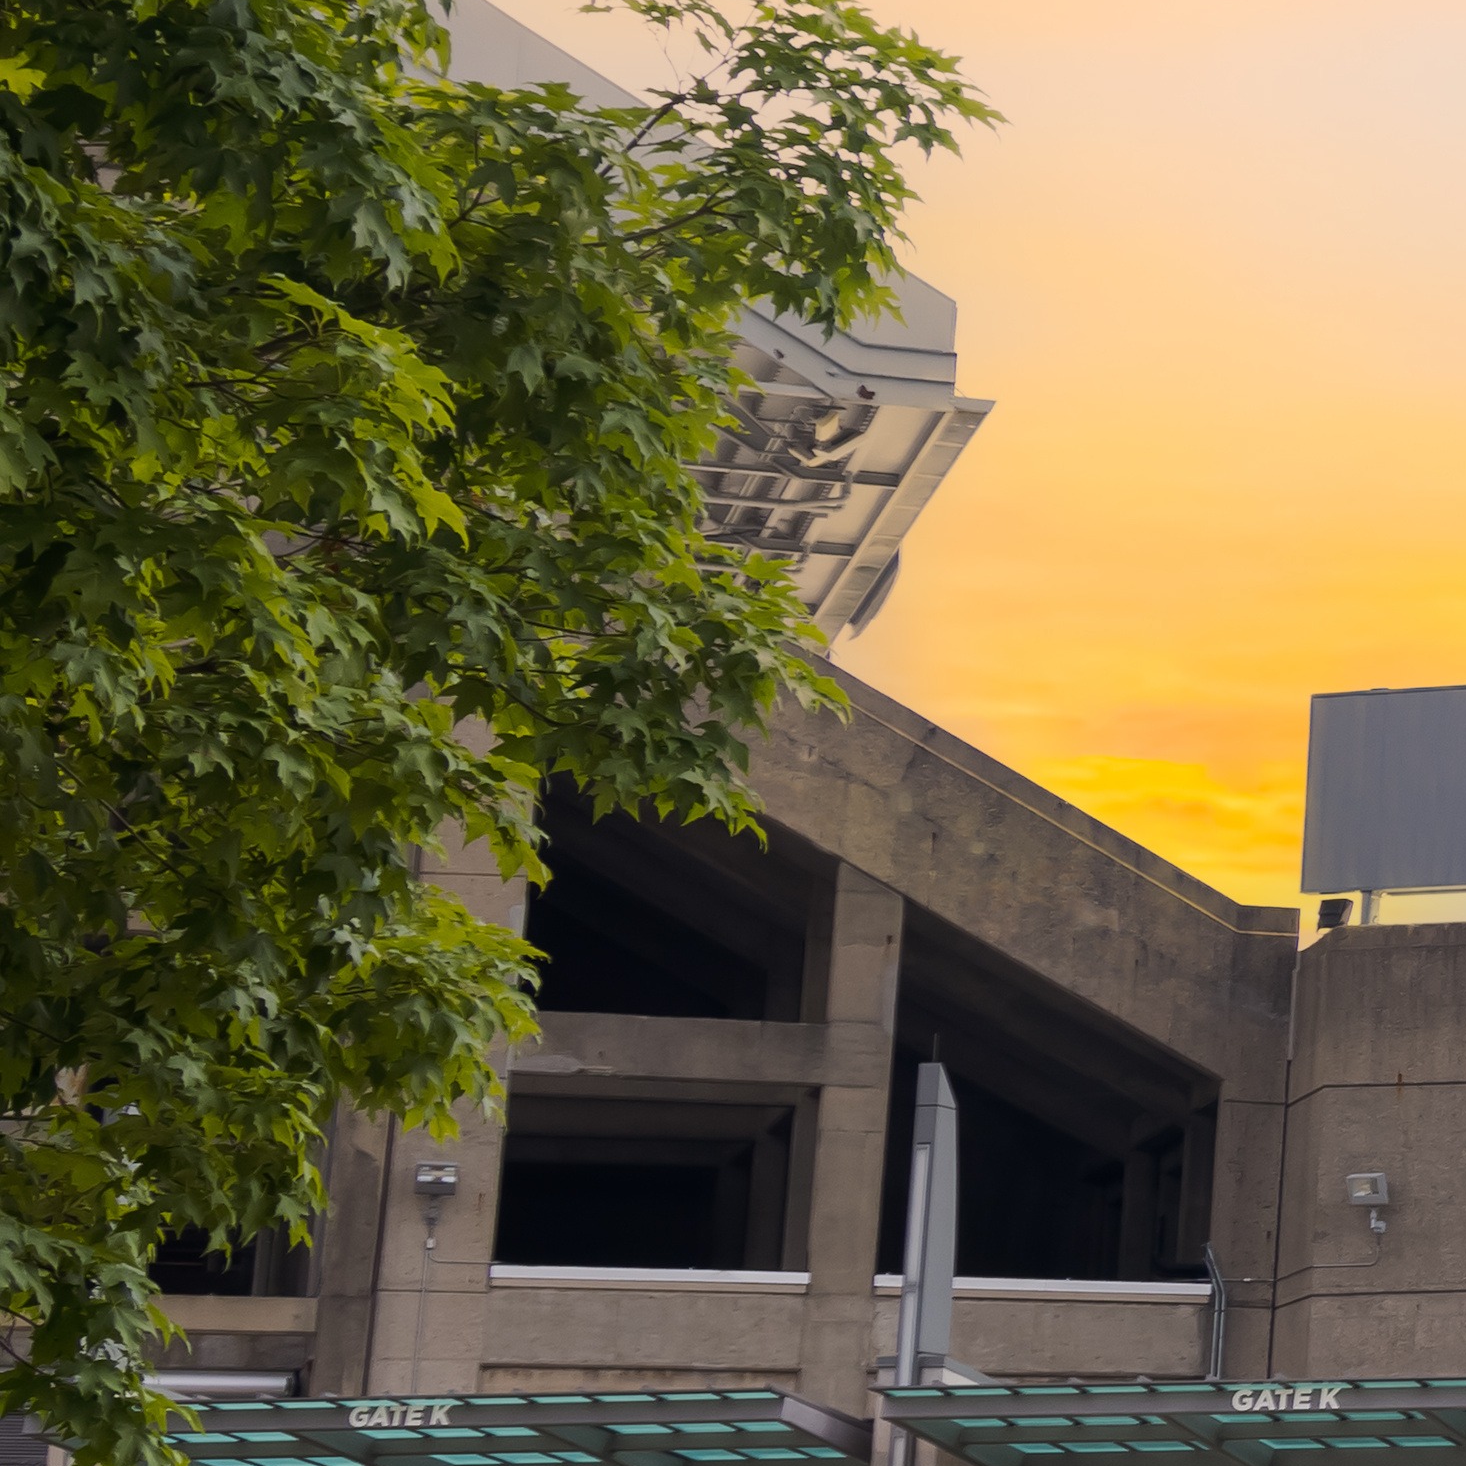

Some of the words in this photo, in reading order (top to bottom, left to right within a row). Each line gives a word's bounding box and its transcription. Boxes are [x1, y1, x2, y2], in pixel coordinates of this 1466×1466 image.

[1231, 1388, 1313, 1412] GATE
[1319, 1387, 1342, 1410] K
[348, 1404, 426, 1428] GATE
[429, 1403, 452, 1426] K
